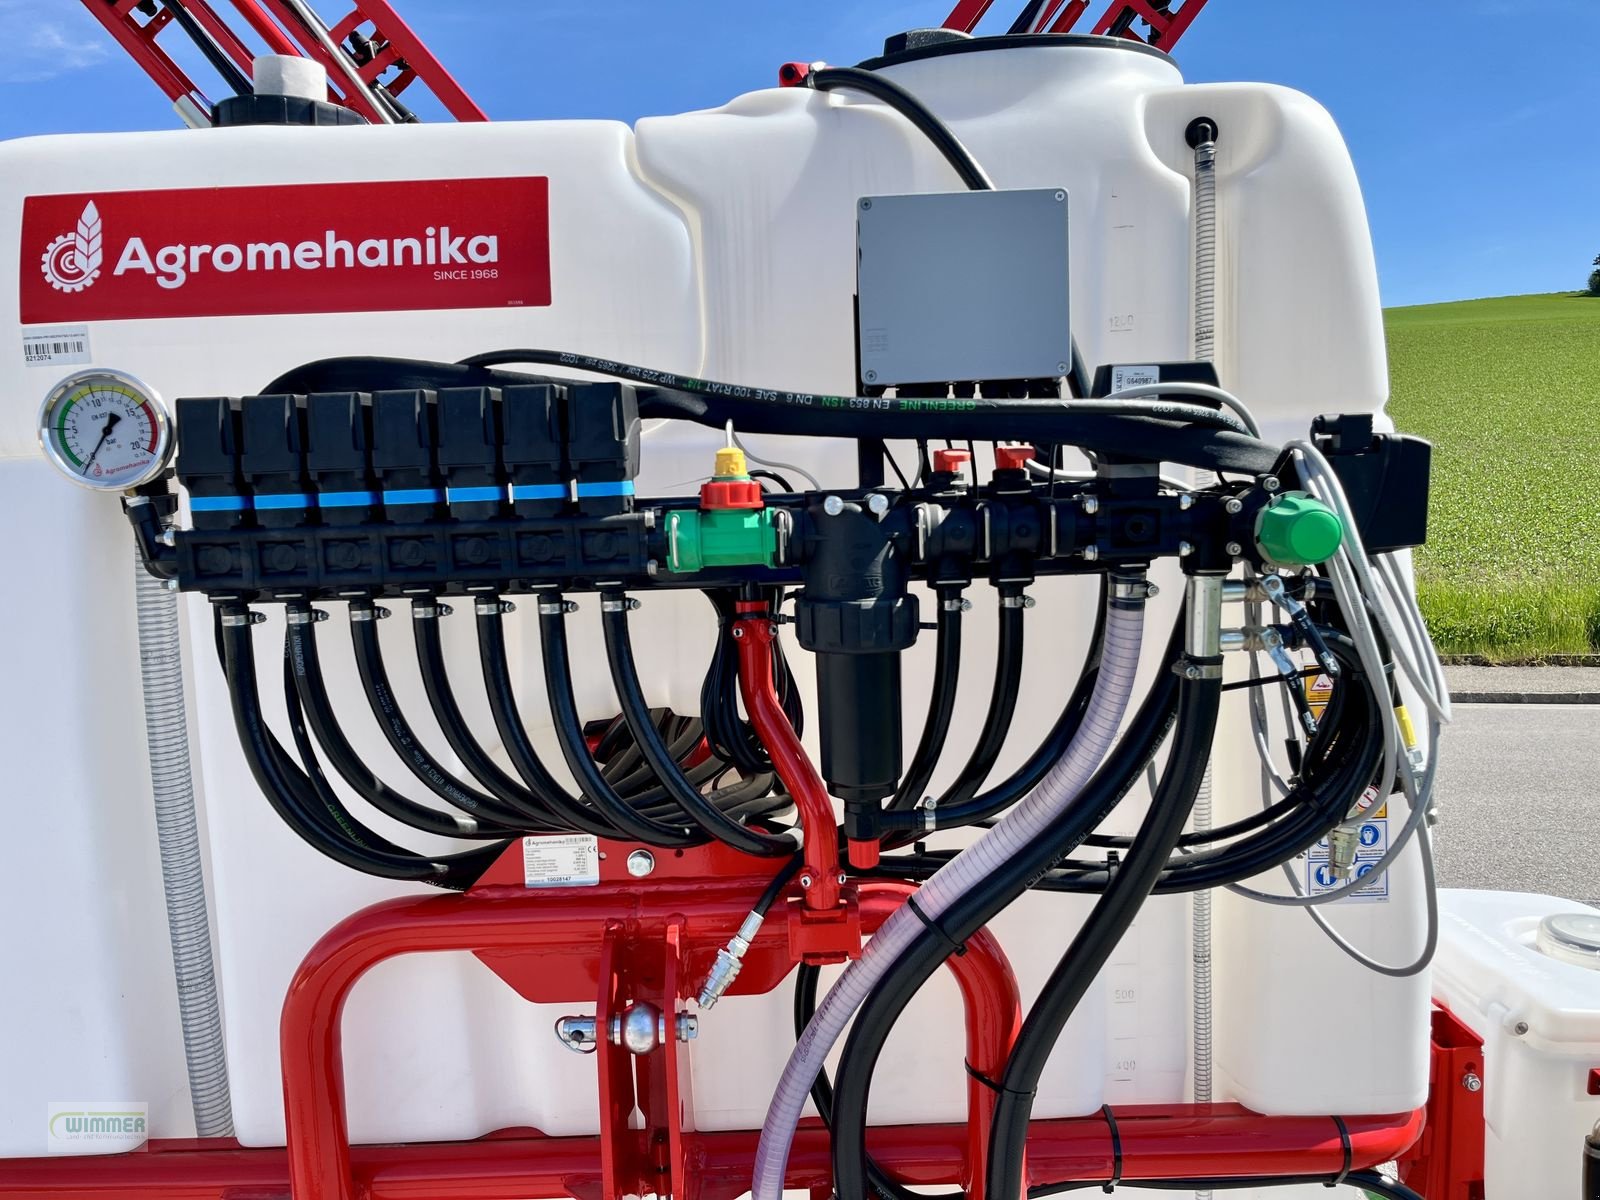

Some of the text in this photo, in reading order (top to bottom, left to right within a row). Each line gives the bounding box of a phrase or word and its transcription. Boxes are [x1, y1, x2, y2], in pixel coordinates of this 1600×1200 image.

[113, 226, 498, 290] Agromehanika
[433, 269, 498, 280] SINCE 1968
[626, 365, 640, 377] bar
[642, 370, 658, 381] 225
[660, 373, 676, 385] WP
[705, 382, 732, 395] R1AT
[734, 387, 752, 398] 100
[755, 389, 777, 401] SAE
[786, 392, 792, 403] 6
[795, 394, 813, 405] DN
[92, 399, 101, 408] 10
[822, 395, 845, 408] 1SN
[849, 399, 869, 409] 853
[873, 400, 890, 410] EN
[900, 400, 977, 410] GREENLINE
[125, 408, 136, 418] 15
[71, 425, 78, 434] 5
[106, 437, 116, 445] bar
[130, 440, 140, 450] 20
